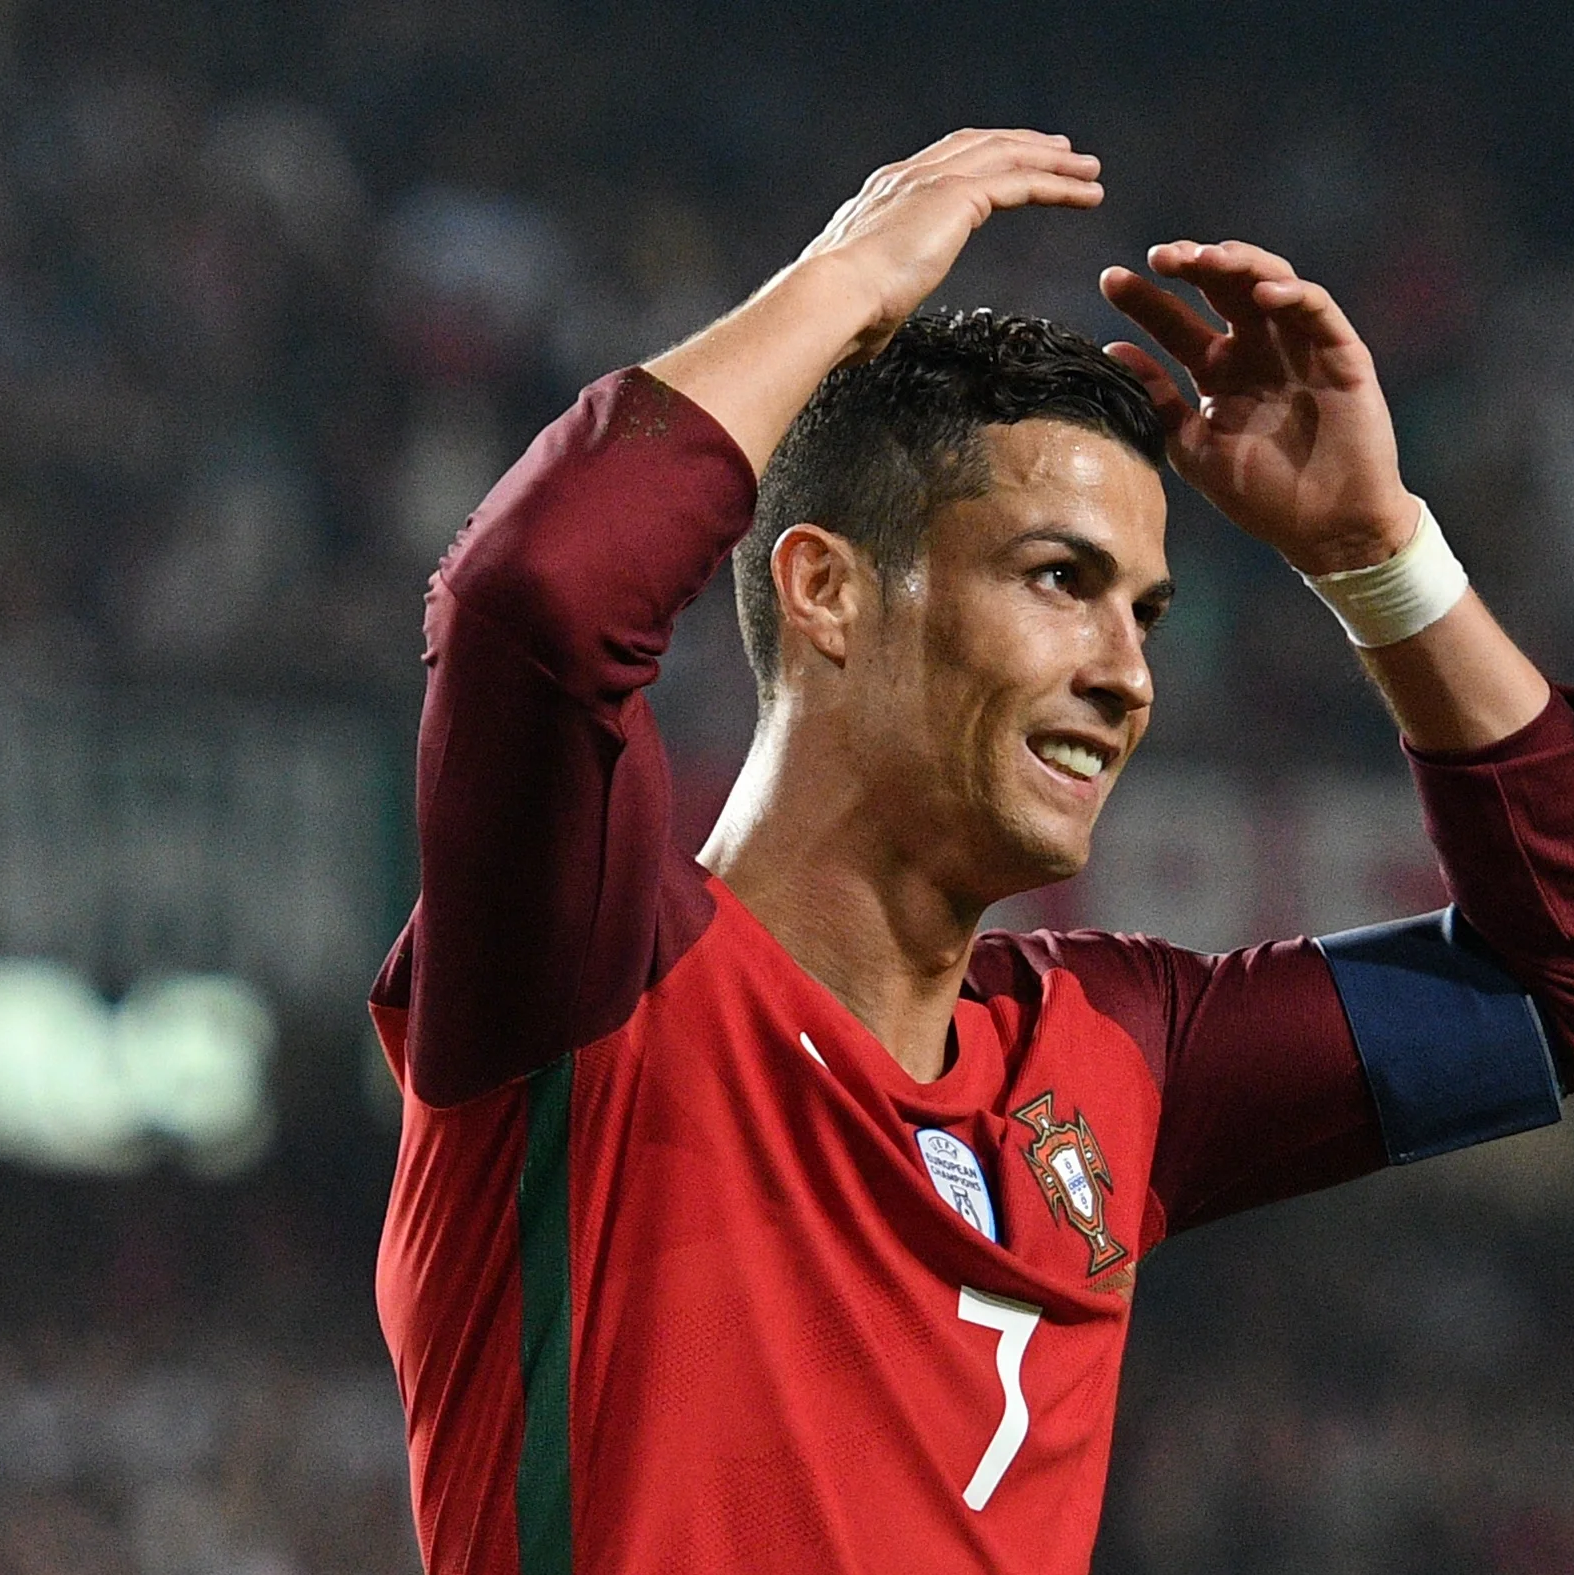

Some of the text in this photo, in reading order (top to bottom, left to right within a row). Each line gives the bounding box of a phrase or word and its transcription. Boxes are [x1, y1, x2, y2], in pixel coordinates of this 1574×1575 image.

[929, 1138, 958, 1159] UEFA
[925, 1152, 978, 1180] EUROPEAN
[930, 1165, 982, 1192] CHAMPIONS
[957, 1284, 1043, 1513] 7
